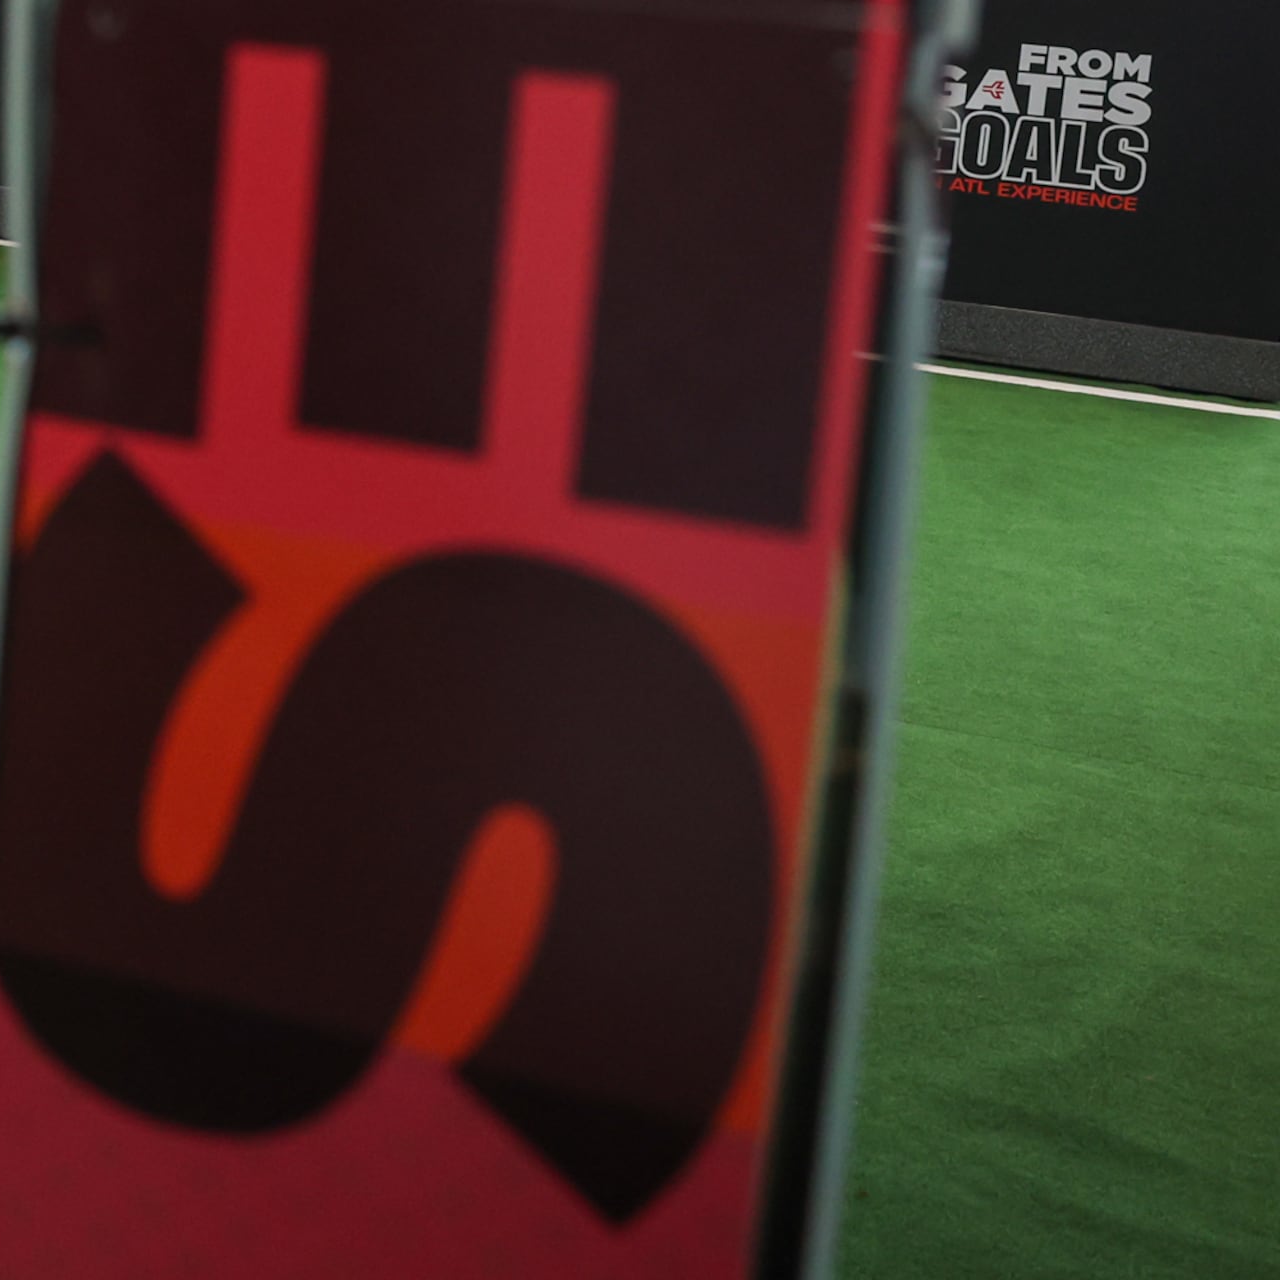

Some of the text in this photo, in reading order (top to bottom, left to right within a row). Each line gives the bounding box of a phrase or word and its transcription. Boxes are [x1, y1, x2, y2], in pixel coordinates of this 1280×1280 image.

[1018, 43, 1152, 83] FROM
[949, 176, 990, 195] ATL
[997, 182, 1138, 211] EXPERIENCE
